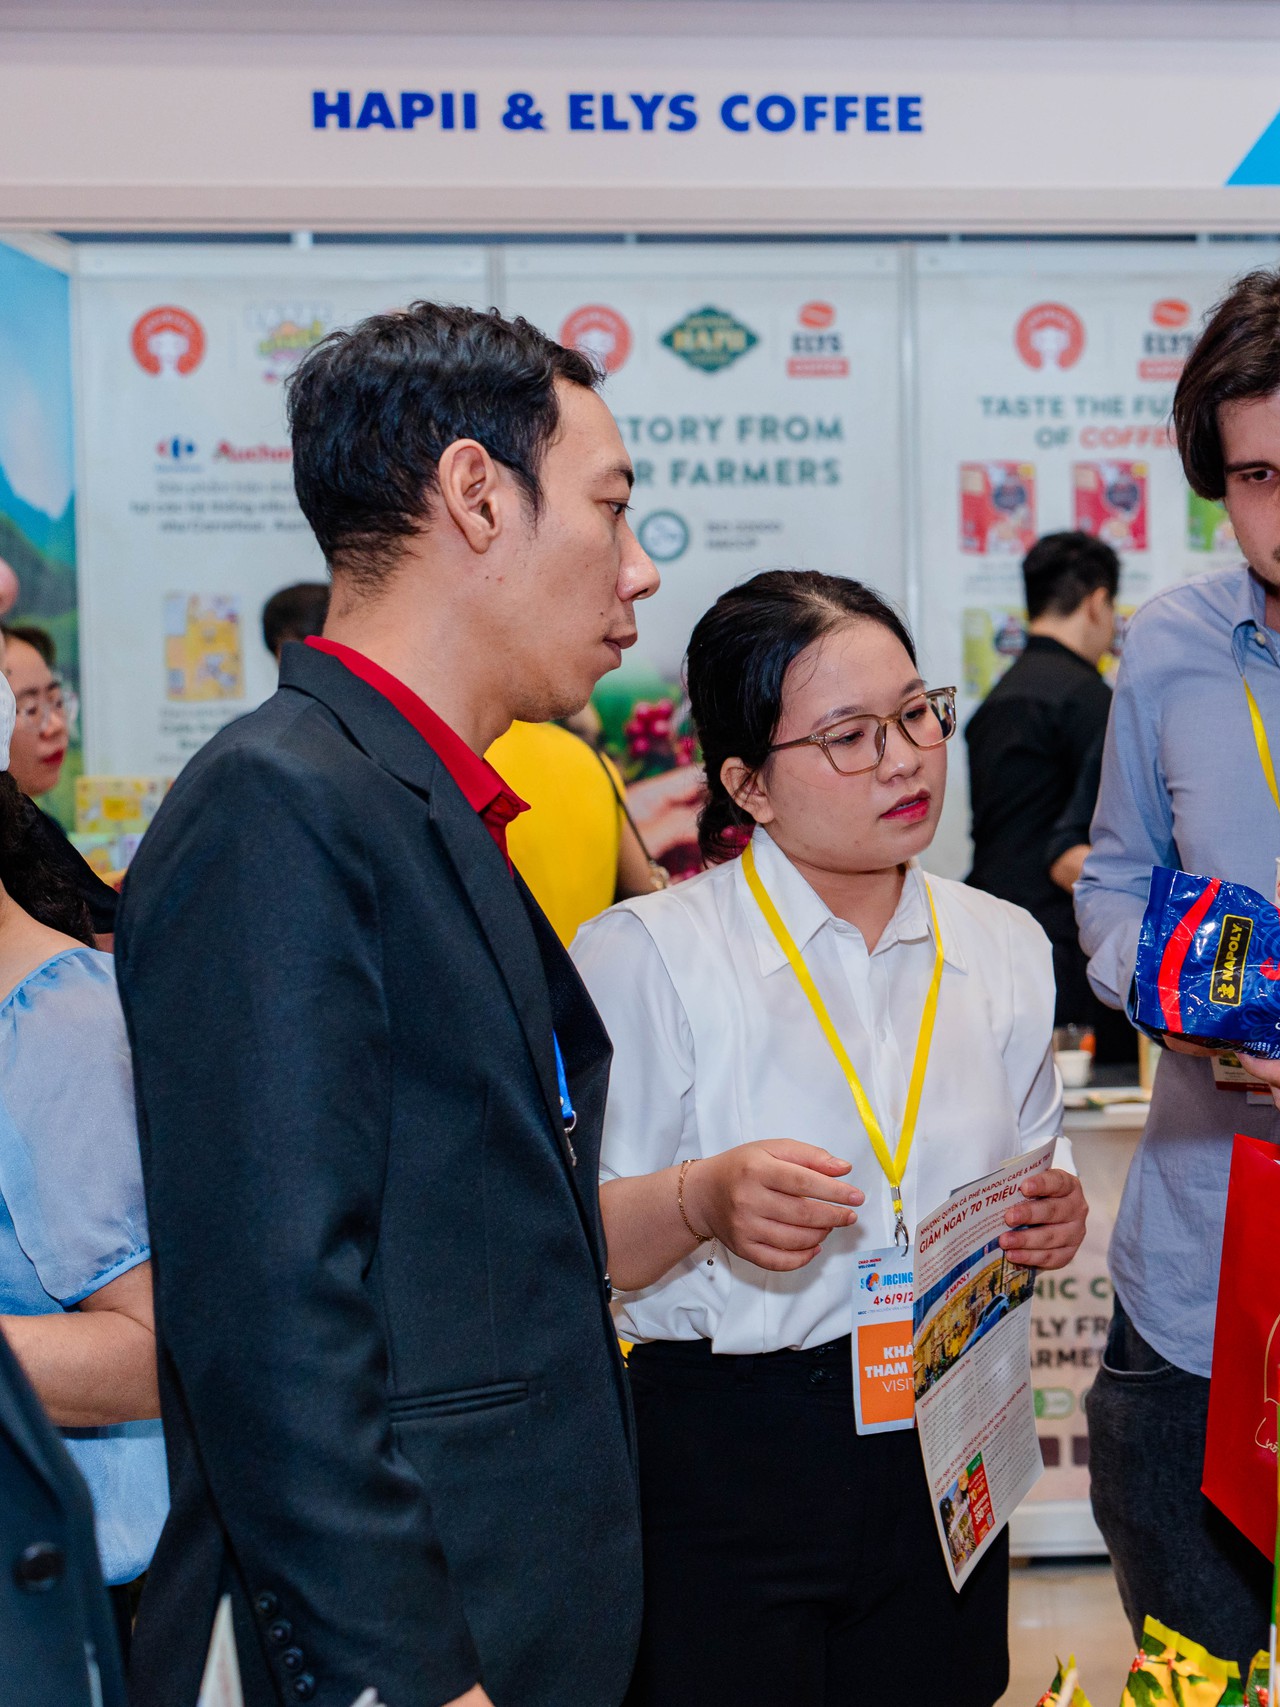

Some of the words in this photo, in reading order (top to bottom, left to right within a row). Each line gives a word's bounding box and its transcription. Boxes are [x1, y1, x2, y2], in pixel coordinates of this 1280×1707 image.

[312, 91, 477, 130] HAPII
[502, 93, 546, 131] &
[569, 94, 698, 131] ELYS
[721, 95, 923, 132] COFFEE
[980, 396, 1063, 417] TASTE
[1074, 396, 1124, 417] THE
[1132, 396, 1172, 417] FU
[616, 415, 724, 443] TORY
[738, 415, 845, 442] FROM
[1034, 425, 1072, 449] OF
[670, 458, 841, 485] FARMERS
[1222, 922, 1243, 981] NAPOLY
[981, 1178, 1007, 1194] NAPOLY
[1029, 1160, 1043, 1172] MILK
[919, 1228, 942, 1254] GIẢM
[943, 1207, 969, 1236] NGAY
[970, 1200, 983, 1216] 70
[985, 1183, 1018, 1207] TRIỆU
[1076, 1315, 1108, 1337] FR
[883, 1341, 914, 1360] KHÁ
[1031, 1347, 1104, 1369] RME
[864, 1361, 909, 1379] THAM
[882, 1377, 915, 1393] VISIT
